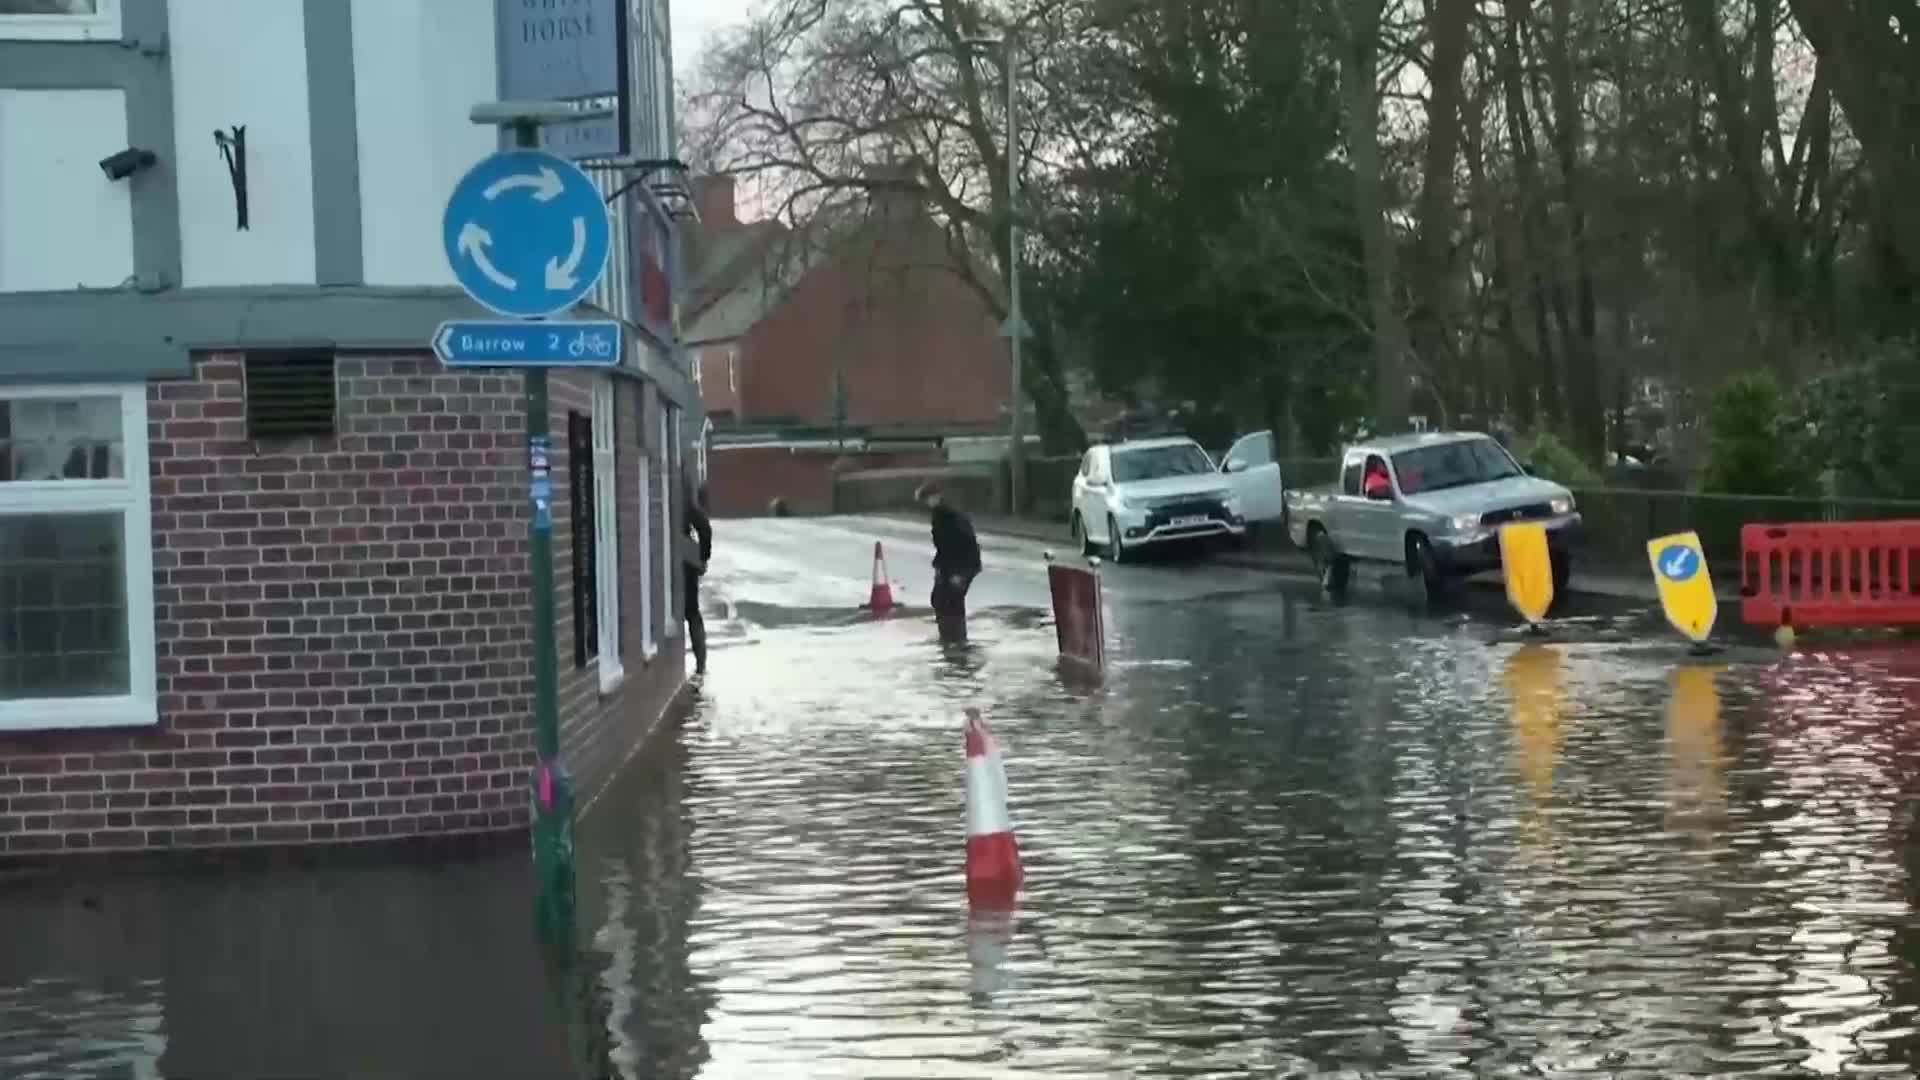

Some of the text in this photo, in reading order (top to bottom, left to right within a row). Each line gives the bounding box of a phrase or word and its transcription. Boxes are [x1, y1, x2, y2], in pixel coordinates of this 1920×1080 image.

[521, 11, 596, 44] HORSE
[461, 334, 560, 352] Barrow 2
